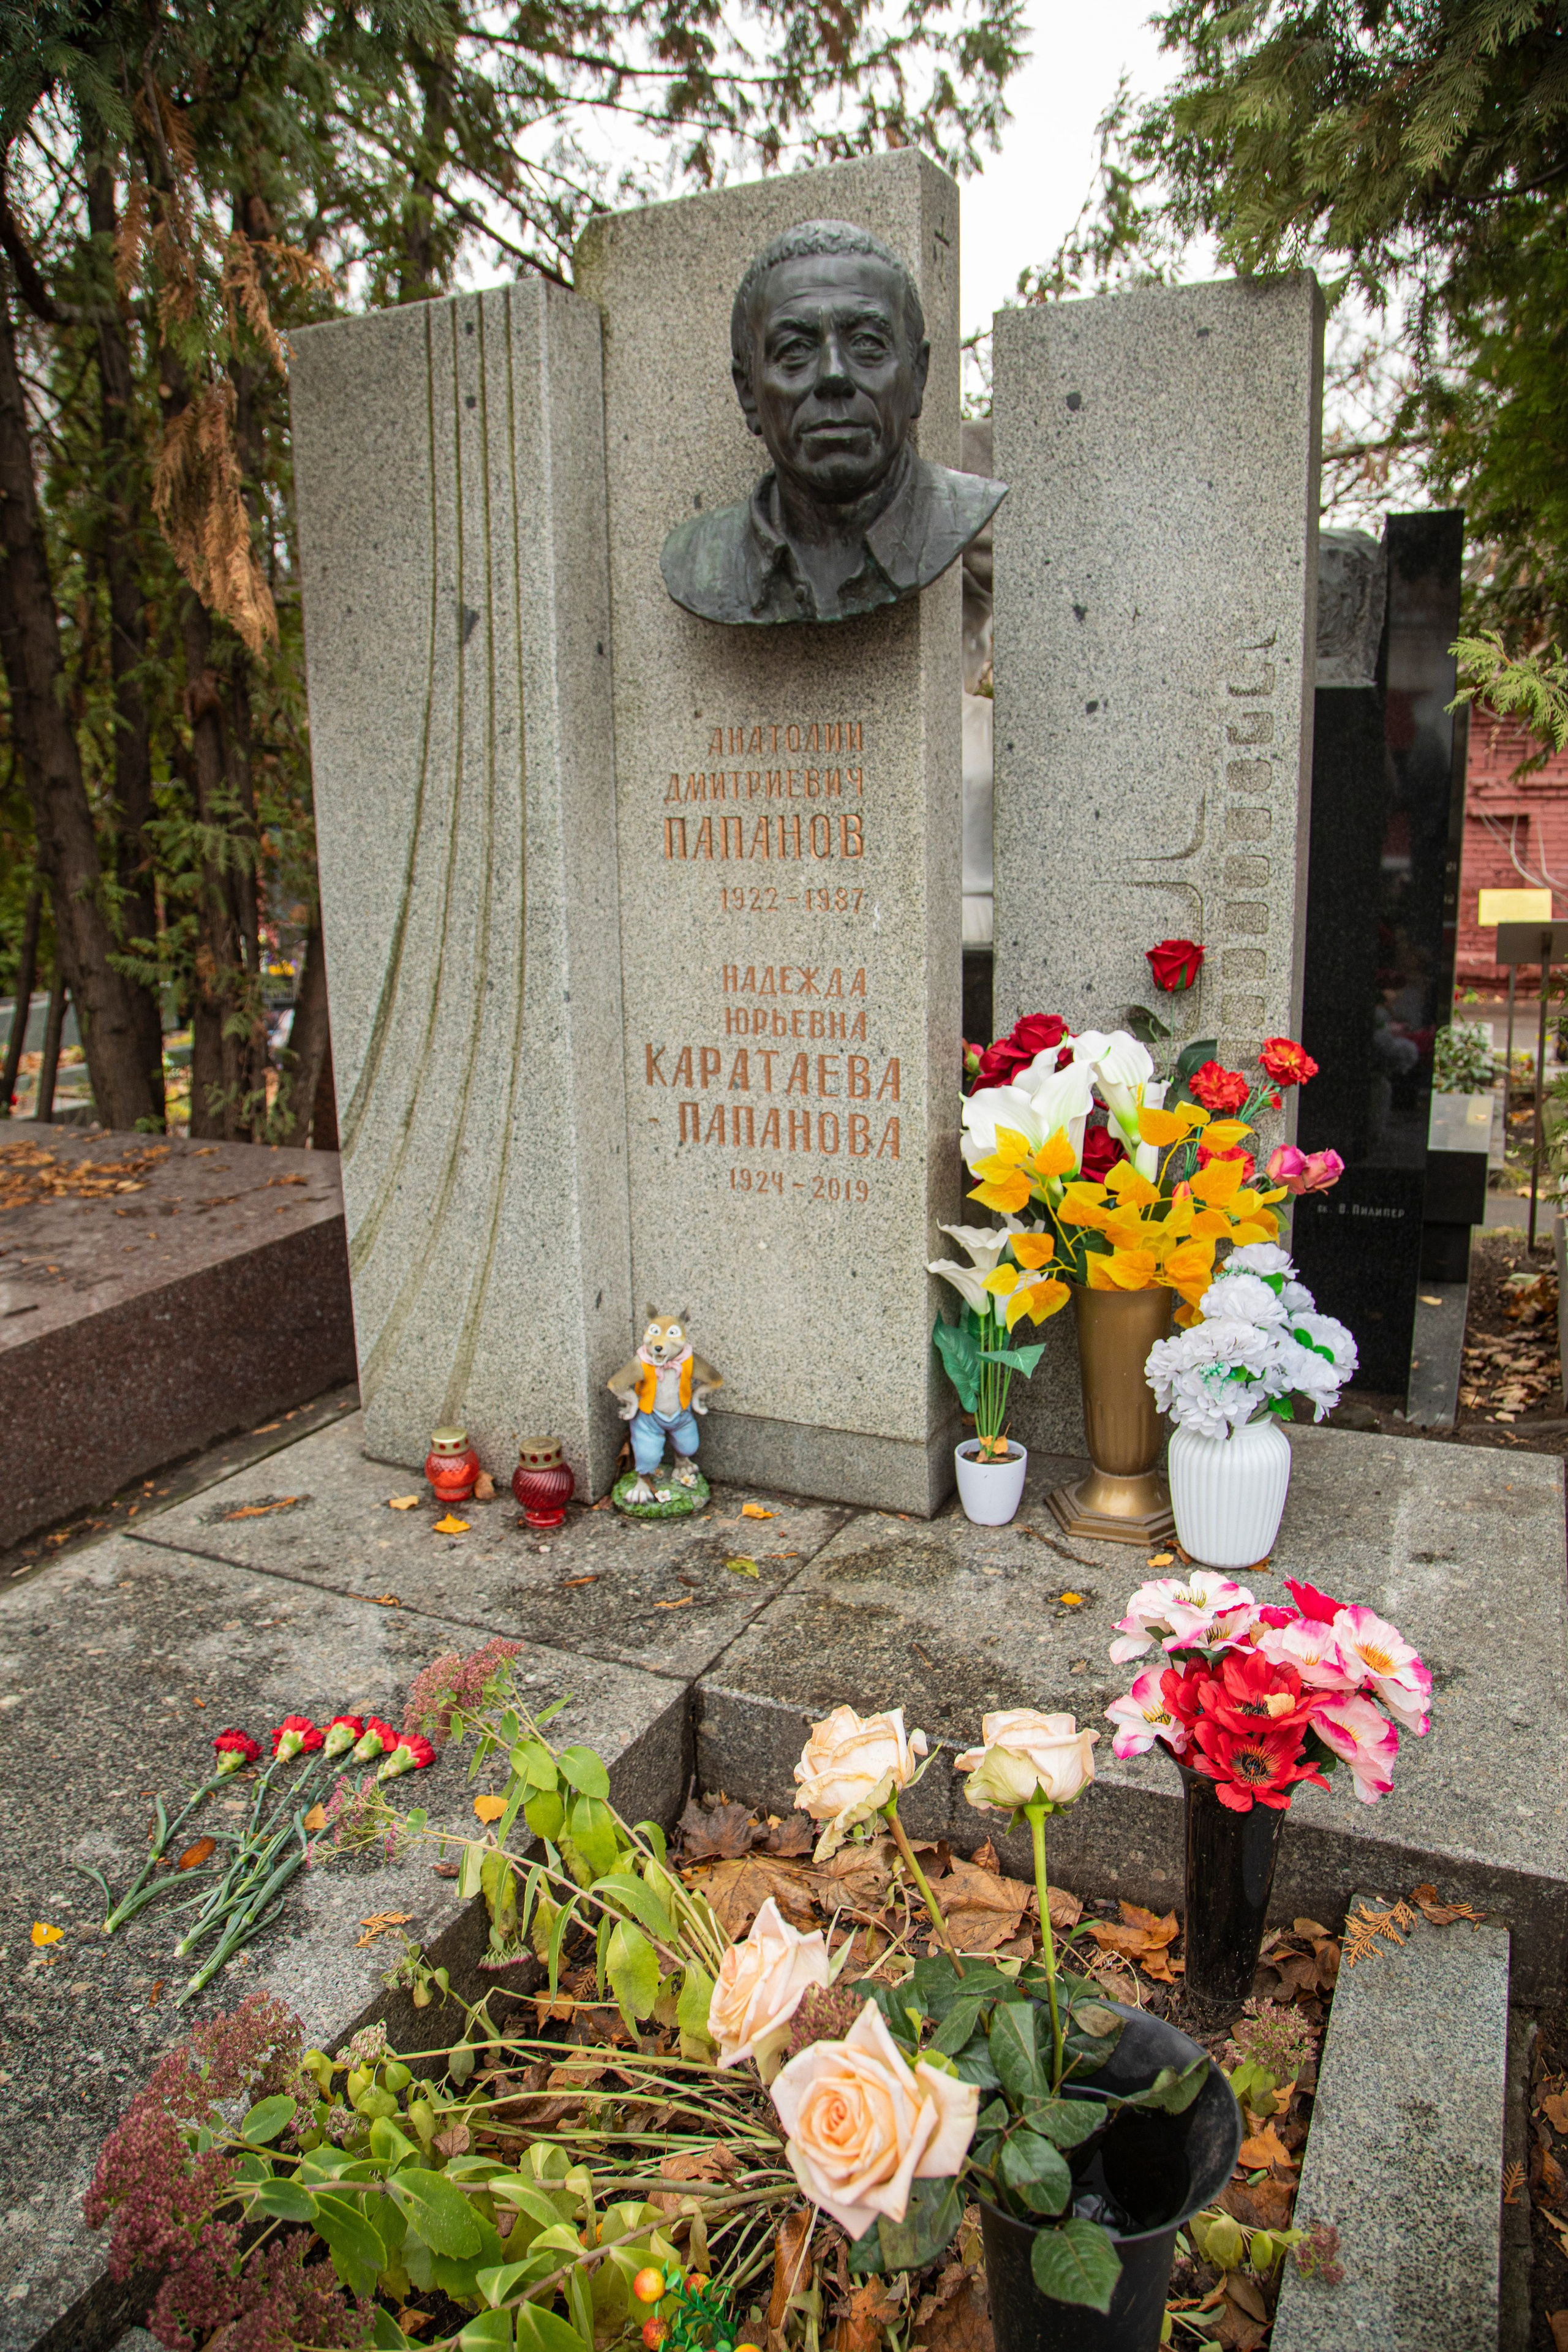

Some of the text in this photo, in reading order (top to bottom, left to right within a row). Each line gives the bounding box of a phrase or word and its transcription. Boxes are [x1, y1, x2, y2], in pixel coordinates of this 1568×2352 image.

[664, 767, 864, 803] ДМИТРИЕВИЧ
[664, 814, 864, 861] ПАПАНОВ
[722, 964, 866, 998] НАДЕЖДА
[725, 1007, 867, 1041] ЮРЬЕВНА
[645, 1043, 900, 1102] КАРАТАЕВА
[679, 1101, 900, 1161] ПАПАНОВА
